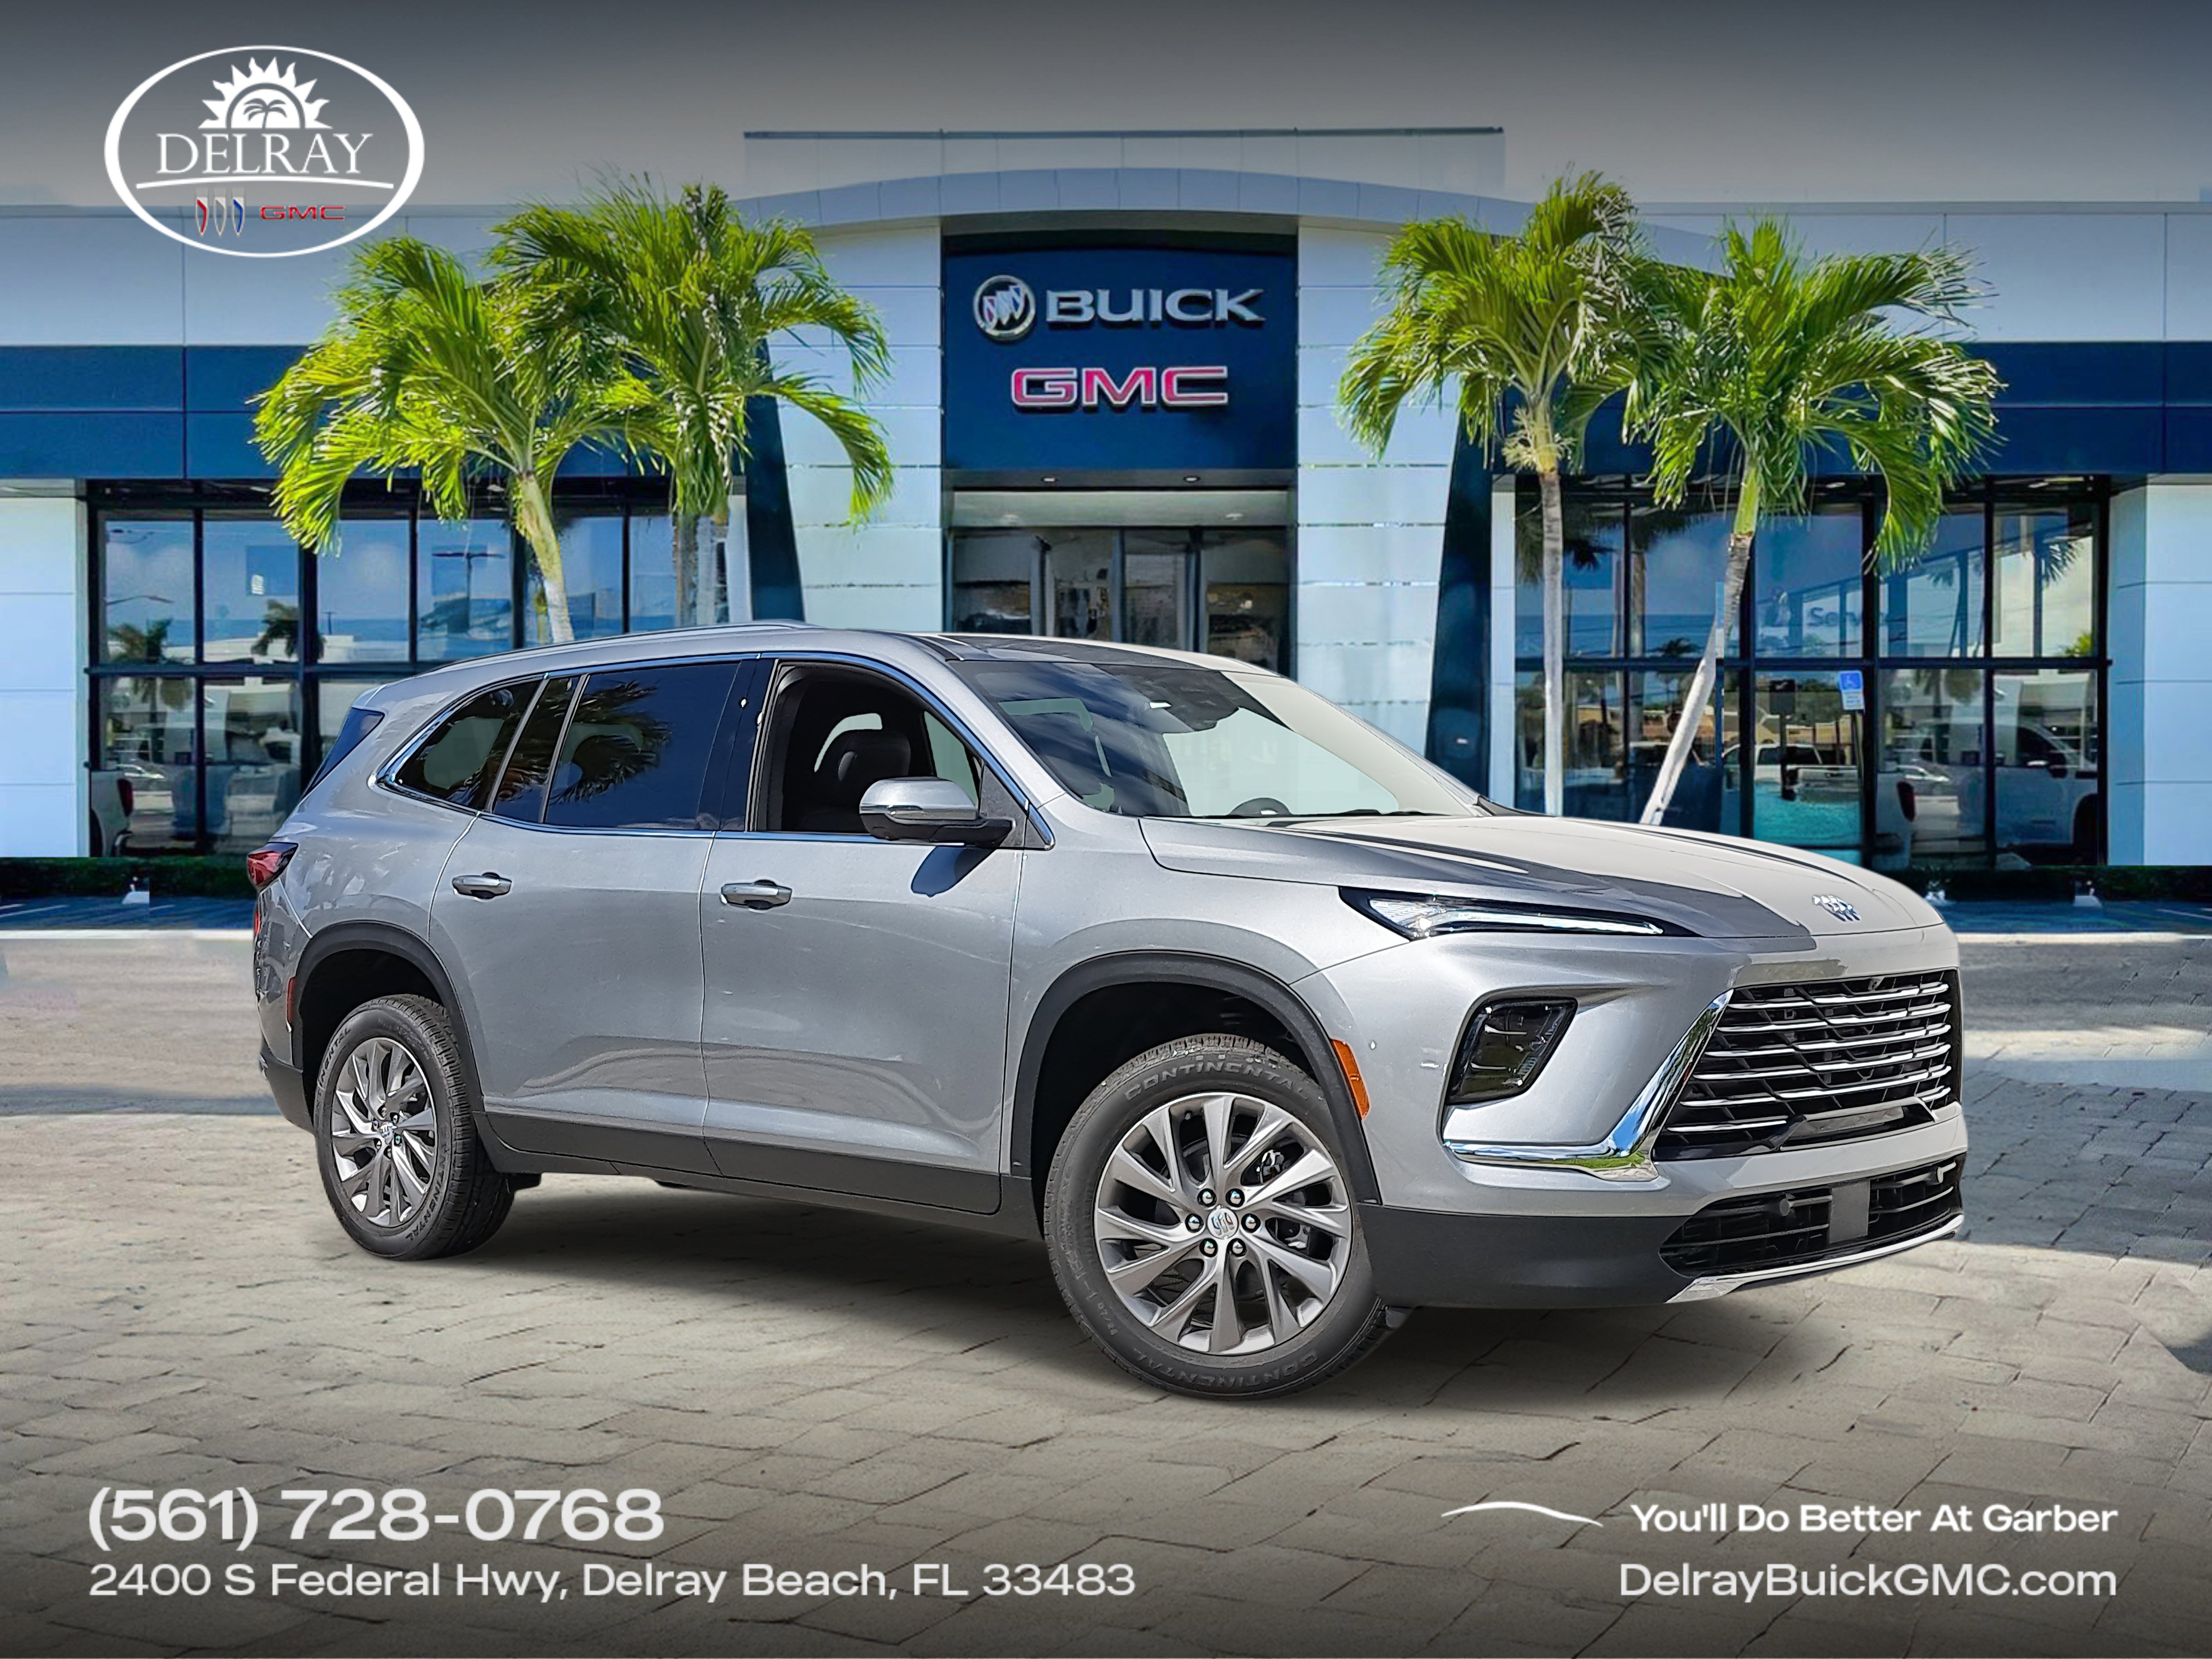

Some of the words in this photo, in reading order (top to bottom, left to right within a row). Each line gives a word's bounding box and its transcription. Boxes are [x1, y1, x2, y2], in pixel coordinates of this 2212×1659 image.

[1046, 289, 1266, 322] BUICK
[1011, 365, 1228, 406] GMC
[1124, 1061, 1308, 1101] CONTINENTAL
